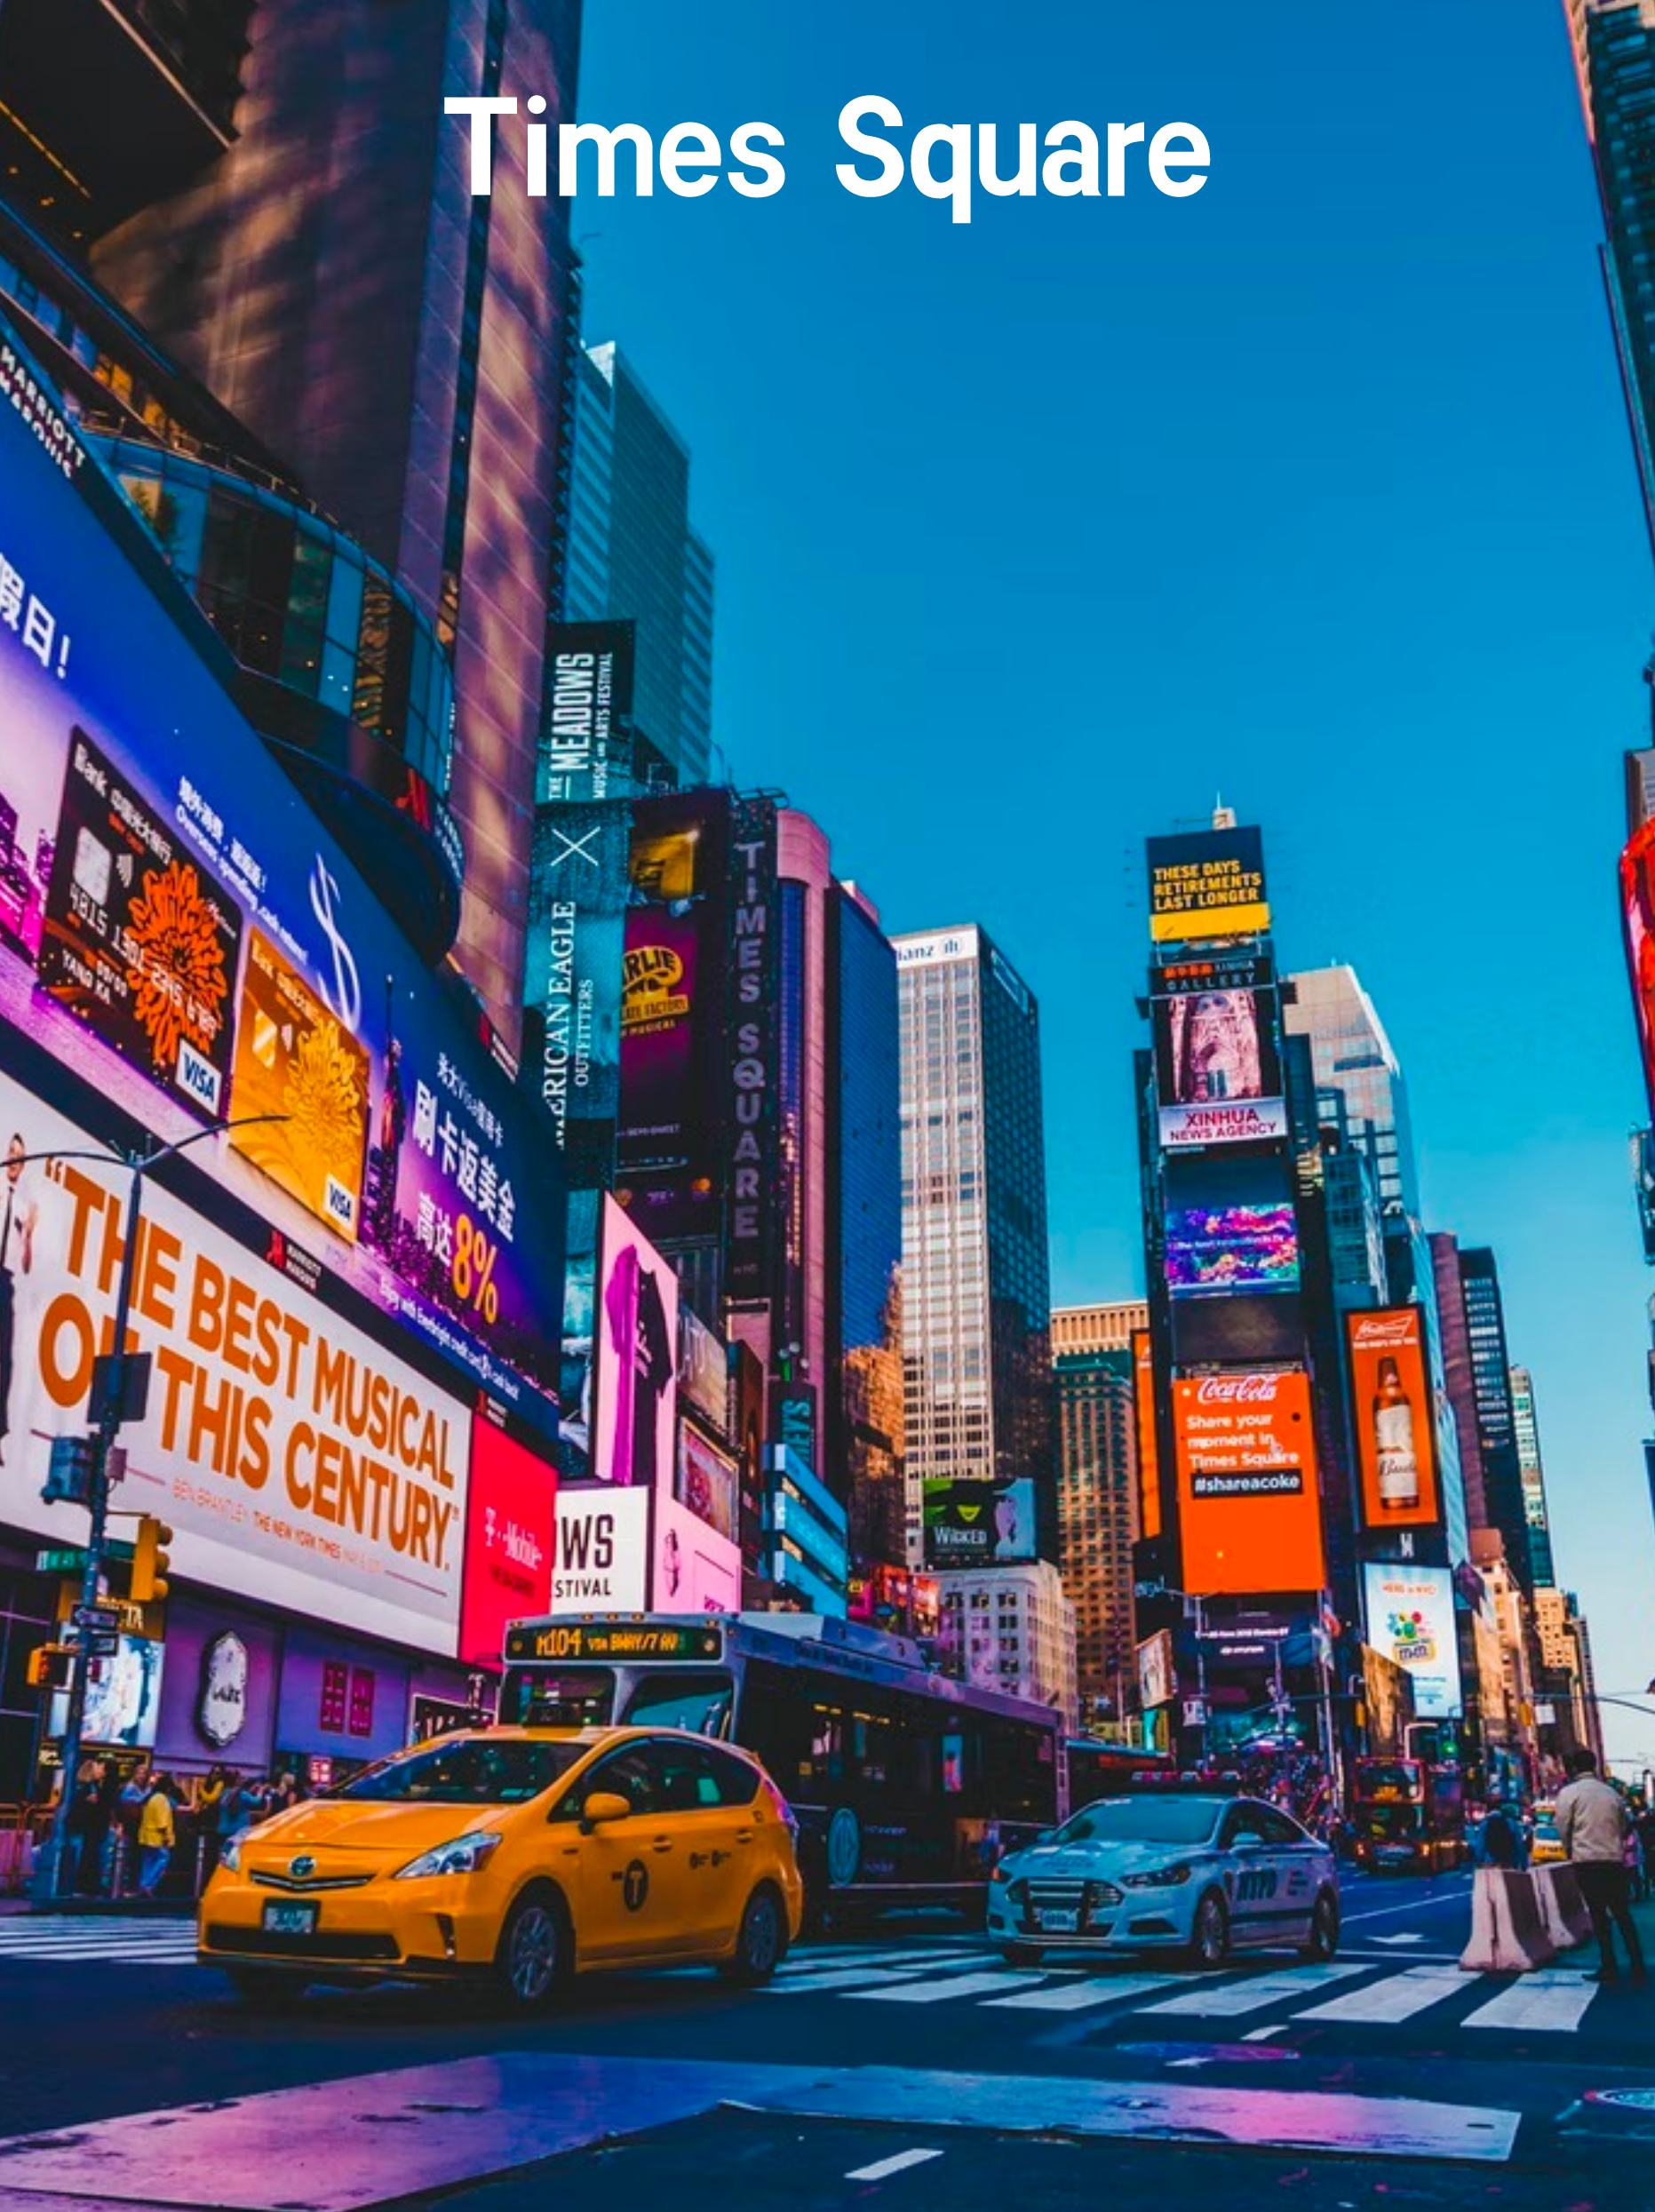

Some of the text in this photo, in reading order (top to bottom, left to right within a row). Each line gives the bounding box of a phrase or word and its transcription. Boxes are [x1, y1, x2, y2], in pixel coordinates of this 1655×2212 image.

[1, 345, 85, 467] MARRIOTT
[596, 651, 613, 706] FESTIVAL
[548, 652, 595, 800] THE MEADOWS
[594, 708, 611, 739] ARTS
[593, 761, 609, 799] MUSIC
[1153, 872, 1262, 896] RETIREMENTS
[1154, 859, 1241, 881] THESE DAYS
[1155, 887, 1259, 911] LAST LONGER
[733, 840, 766, 1004] TIMES
[623, 948, 678, 982] RLIE
[1166, 972, 1255, 991] GALLERY
[542, 901, 577, 1151] ERICAN EAGLE
[574, 978, 593, 1087] OUTFITTERS
[182, 1052, 216, 1102] VISA
[733, 1022, 768, 1239] SQUARE
[1170, 1122, 1277, 1142] NEWS AGENCY
[1185, 1107, 1260, 1129] XINHUA
[453, 1213, 499, 1325] 8%
[187, 1253, 310, 1401] BEST
[313, 1336, 455, 1490] MUSICAL
[156, 1344, 274, 1491] THIS
[1186, 1414, 1273, 1430] Share your
[1188, 1432, 1256, 1450] moment
[1189, 1451, 1300, 1469] Times Square
[1194, 1473, 1300, 1492] #shareacoke
[253, 1509, 271, 1533] THE
[316, 1536, 341, 1559] TIMES
[555, 1514, 614, 1571] WS
[554, 1578, 612, 1598] STIVAL
